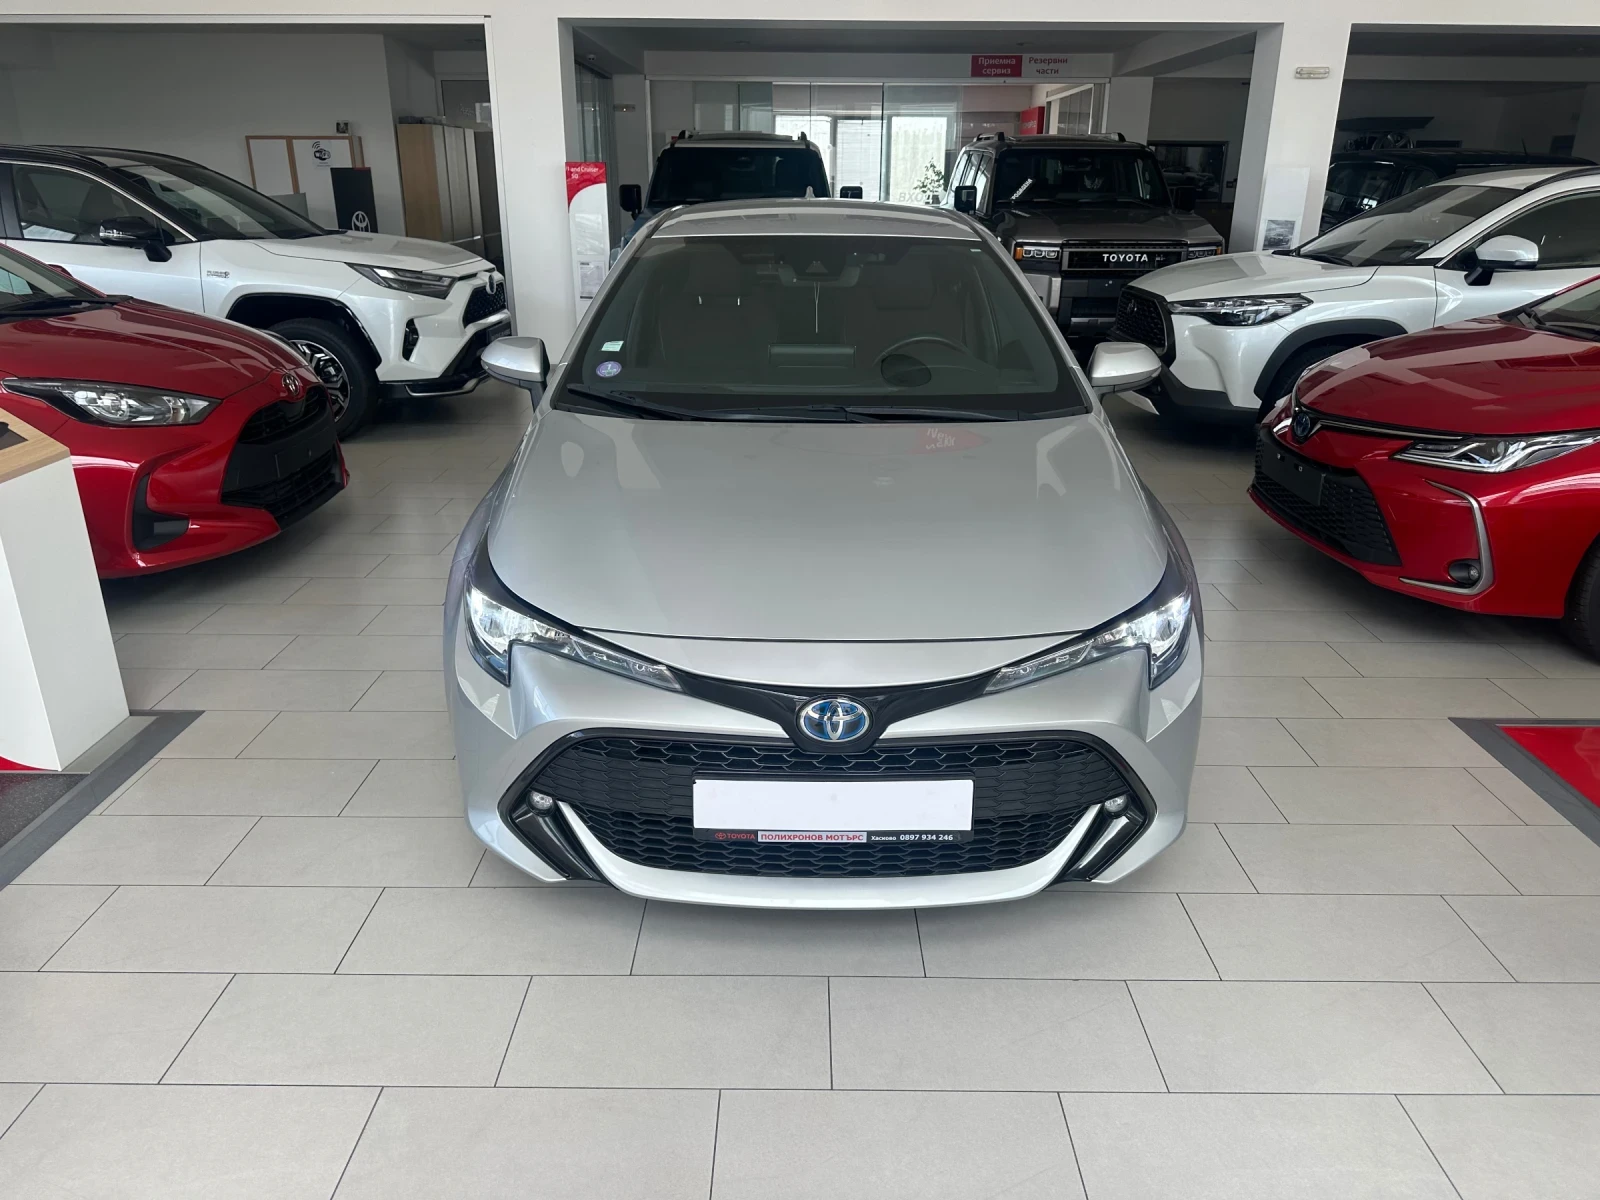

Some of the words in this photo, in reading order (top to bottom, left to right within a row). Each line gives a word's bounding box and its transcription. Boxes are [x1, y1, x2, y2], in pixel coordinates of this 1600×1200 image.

[978, 57, 1016, 67] Приемна
[1028, 56, 1068, 66] Резервни
[982, 67, 1011, 76] сервиз
[1035, 67, 1059, 75] части
[898, 192, 933, 204] ВХОД
[1102, 253, 1149, 262] TOYOTA
[760, 833, 823, 841] ПОЛИХРОНОВ
